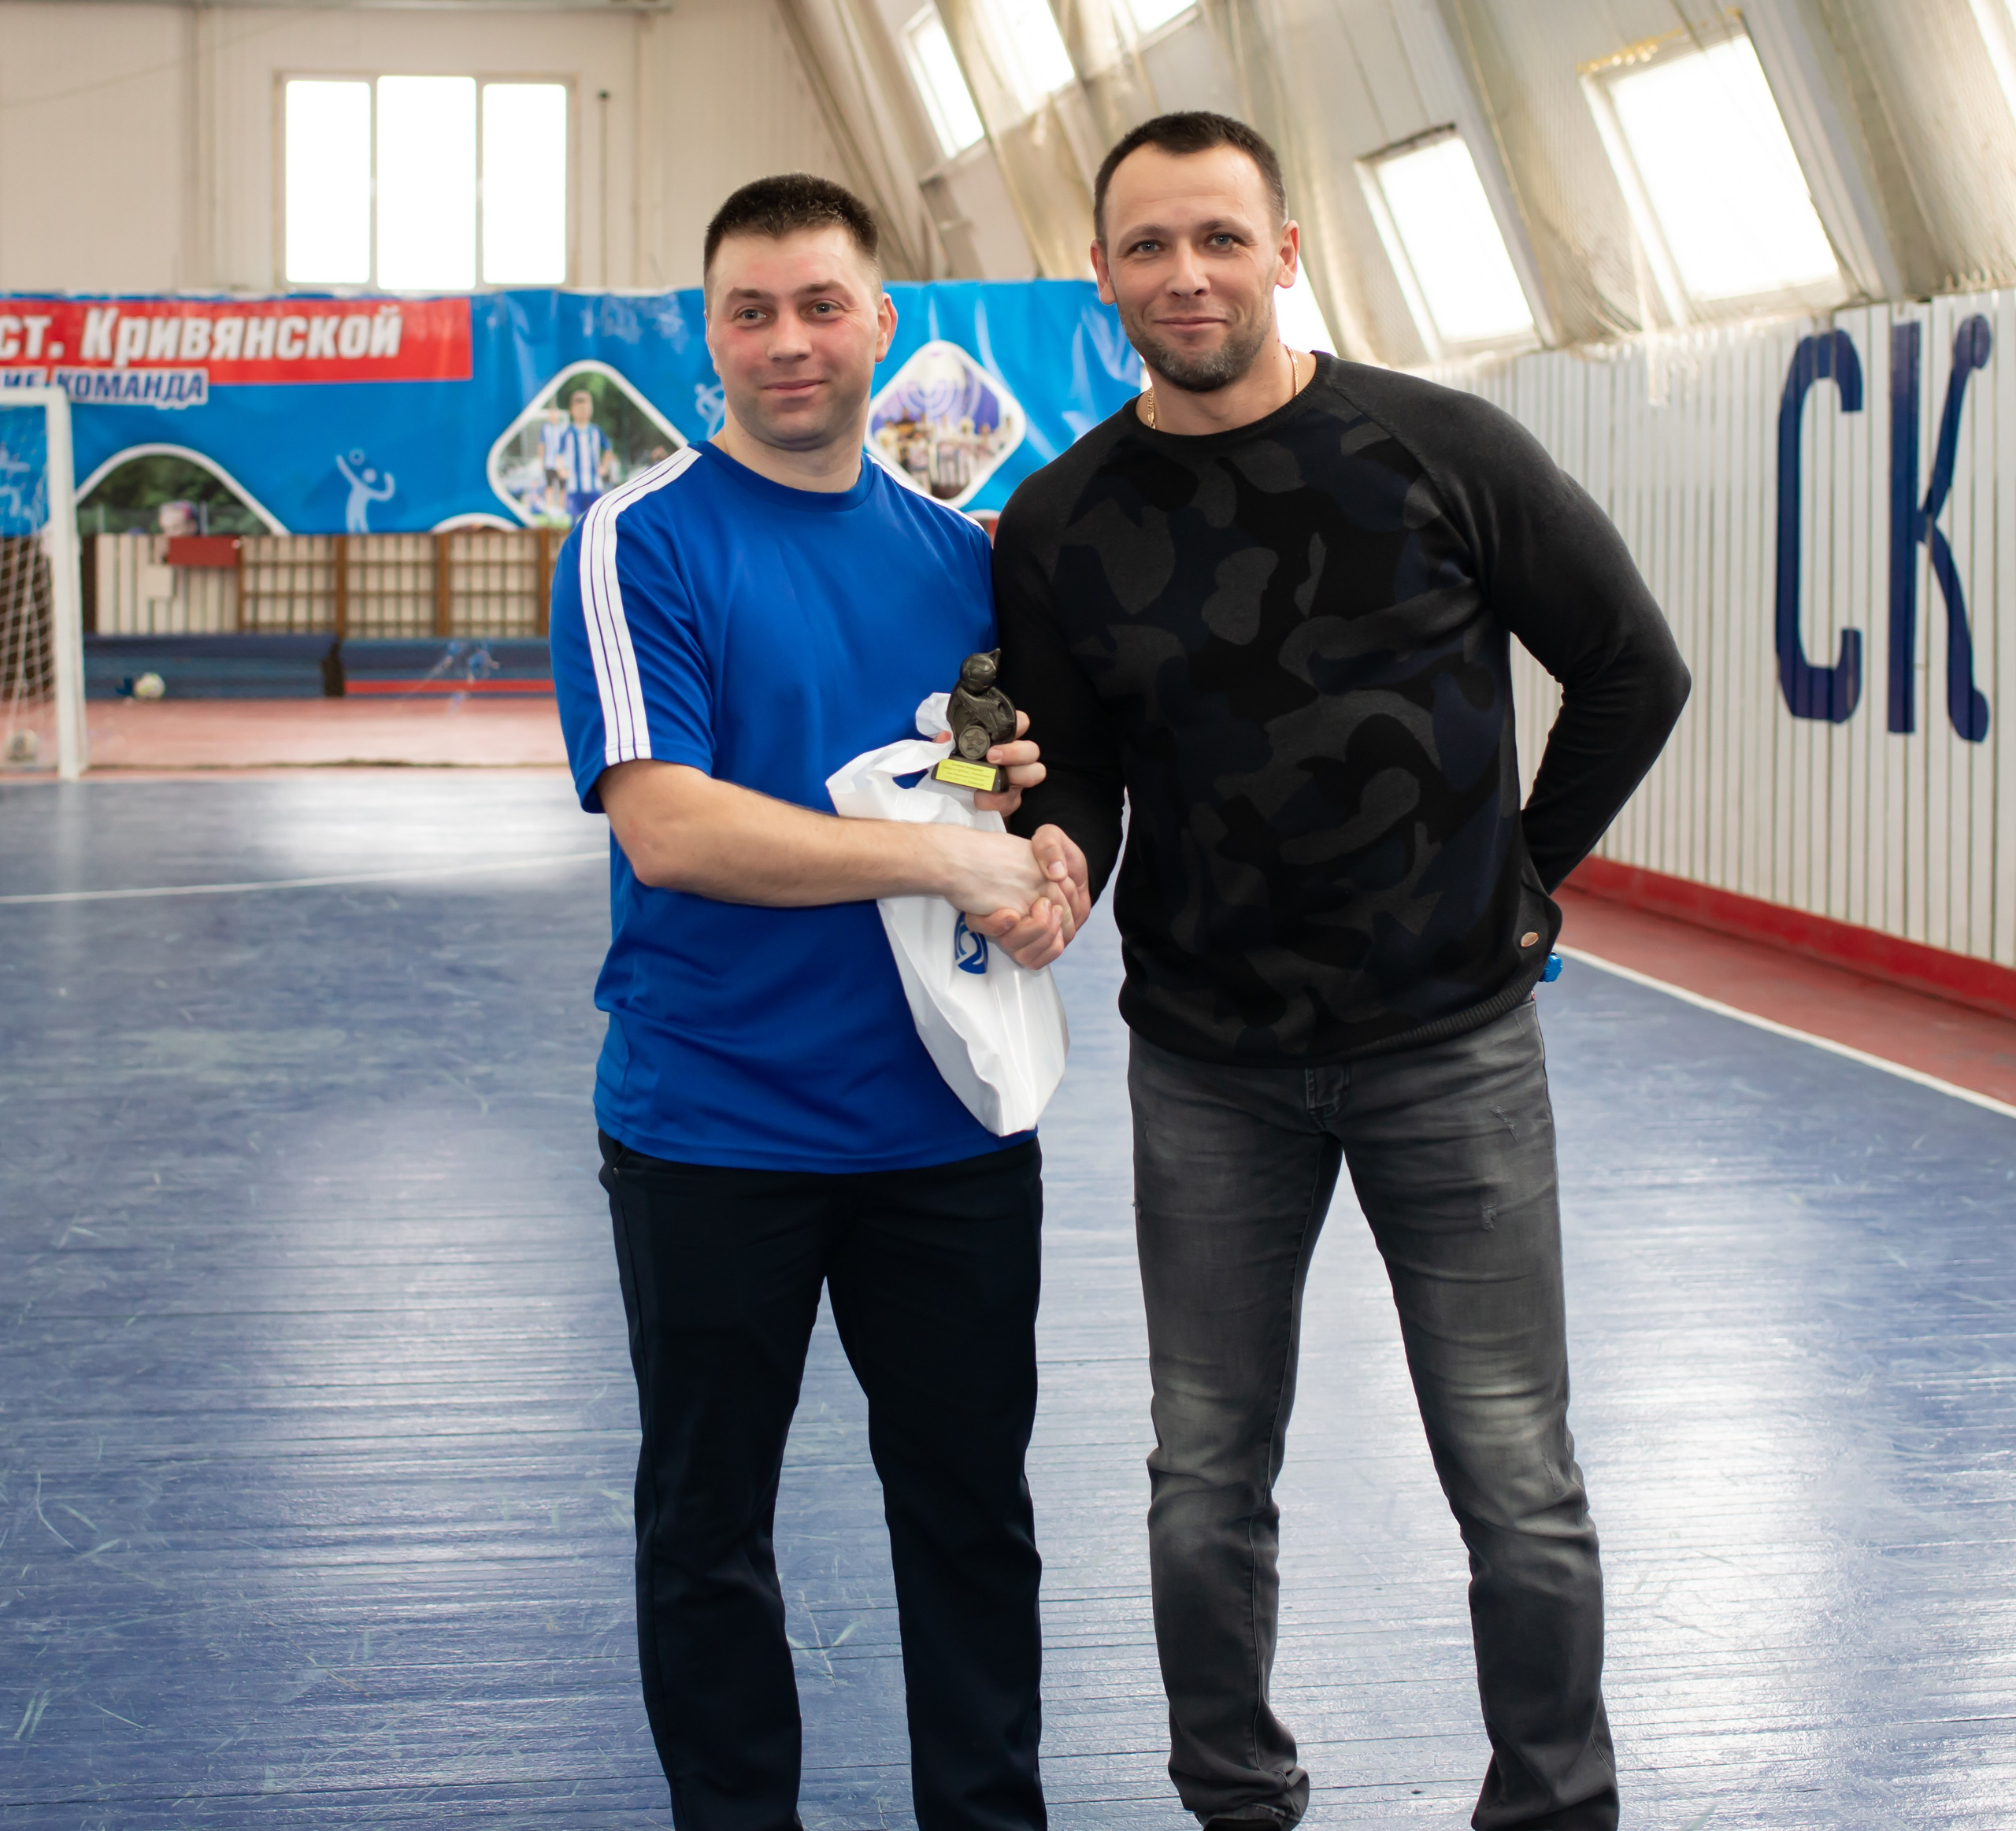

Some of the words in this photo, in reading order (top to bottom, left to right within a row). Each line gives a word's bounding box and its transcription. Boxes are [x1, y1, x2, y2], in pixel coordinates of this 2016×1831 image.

[0, 315, 65, 359] ст.
[80, 305, 403, 368] Кривянской
[57, 373, 203, 401] КОМАНДА
[1775, 313, 1992, 743] СК
